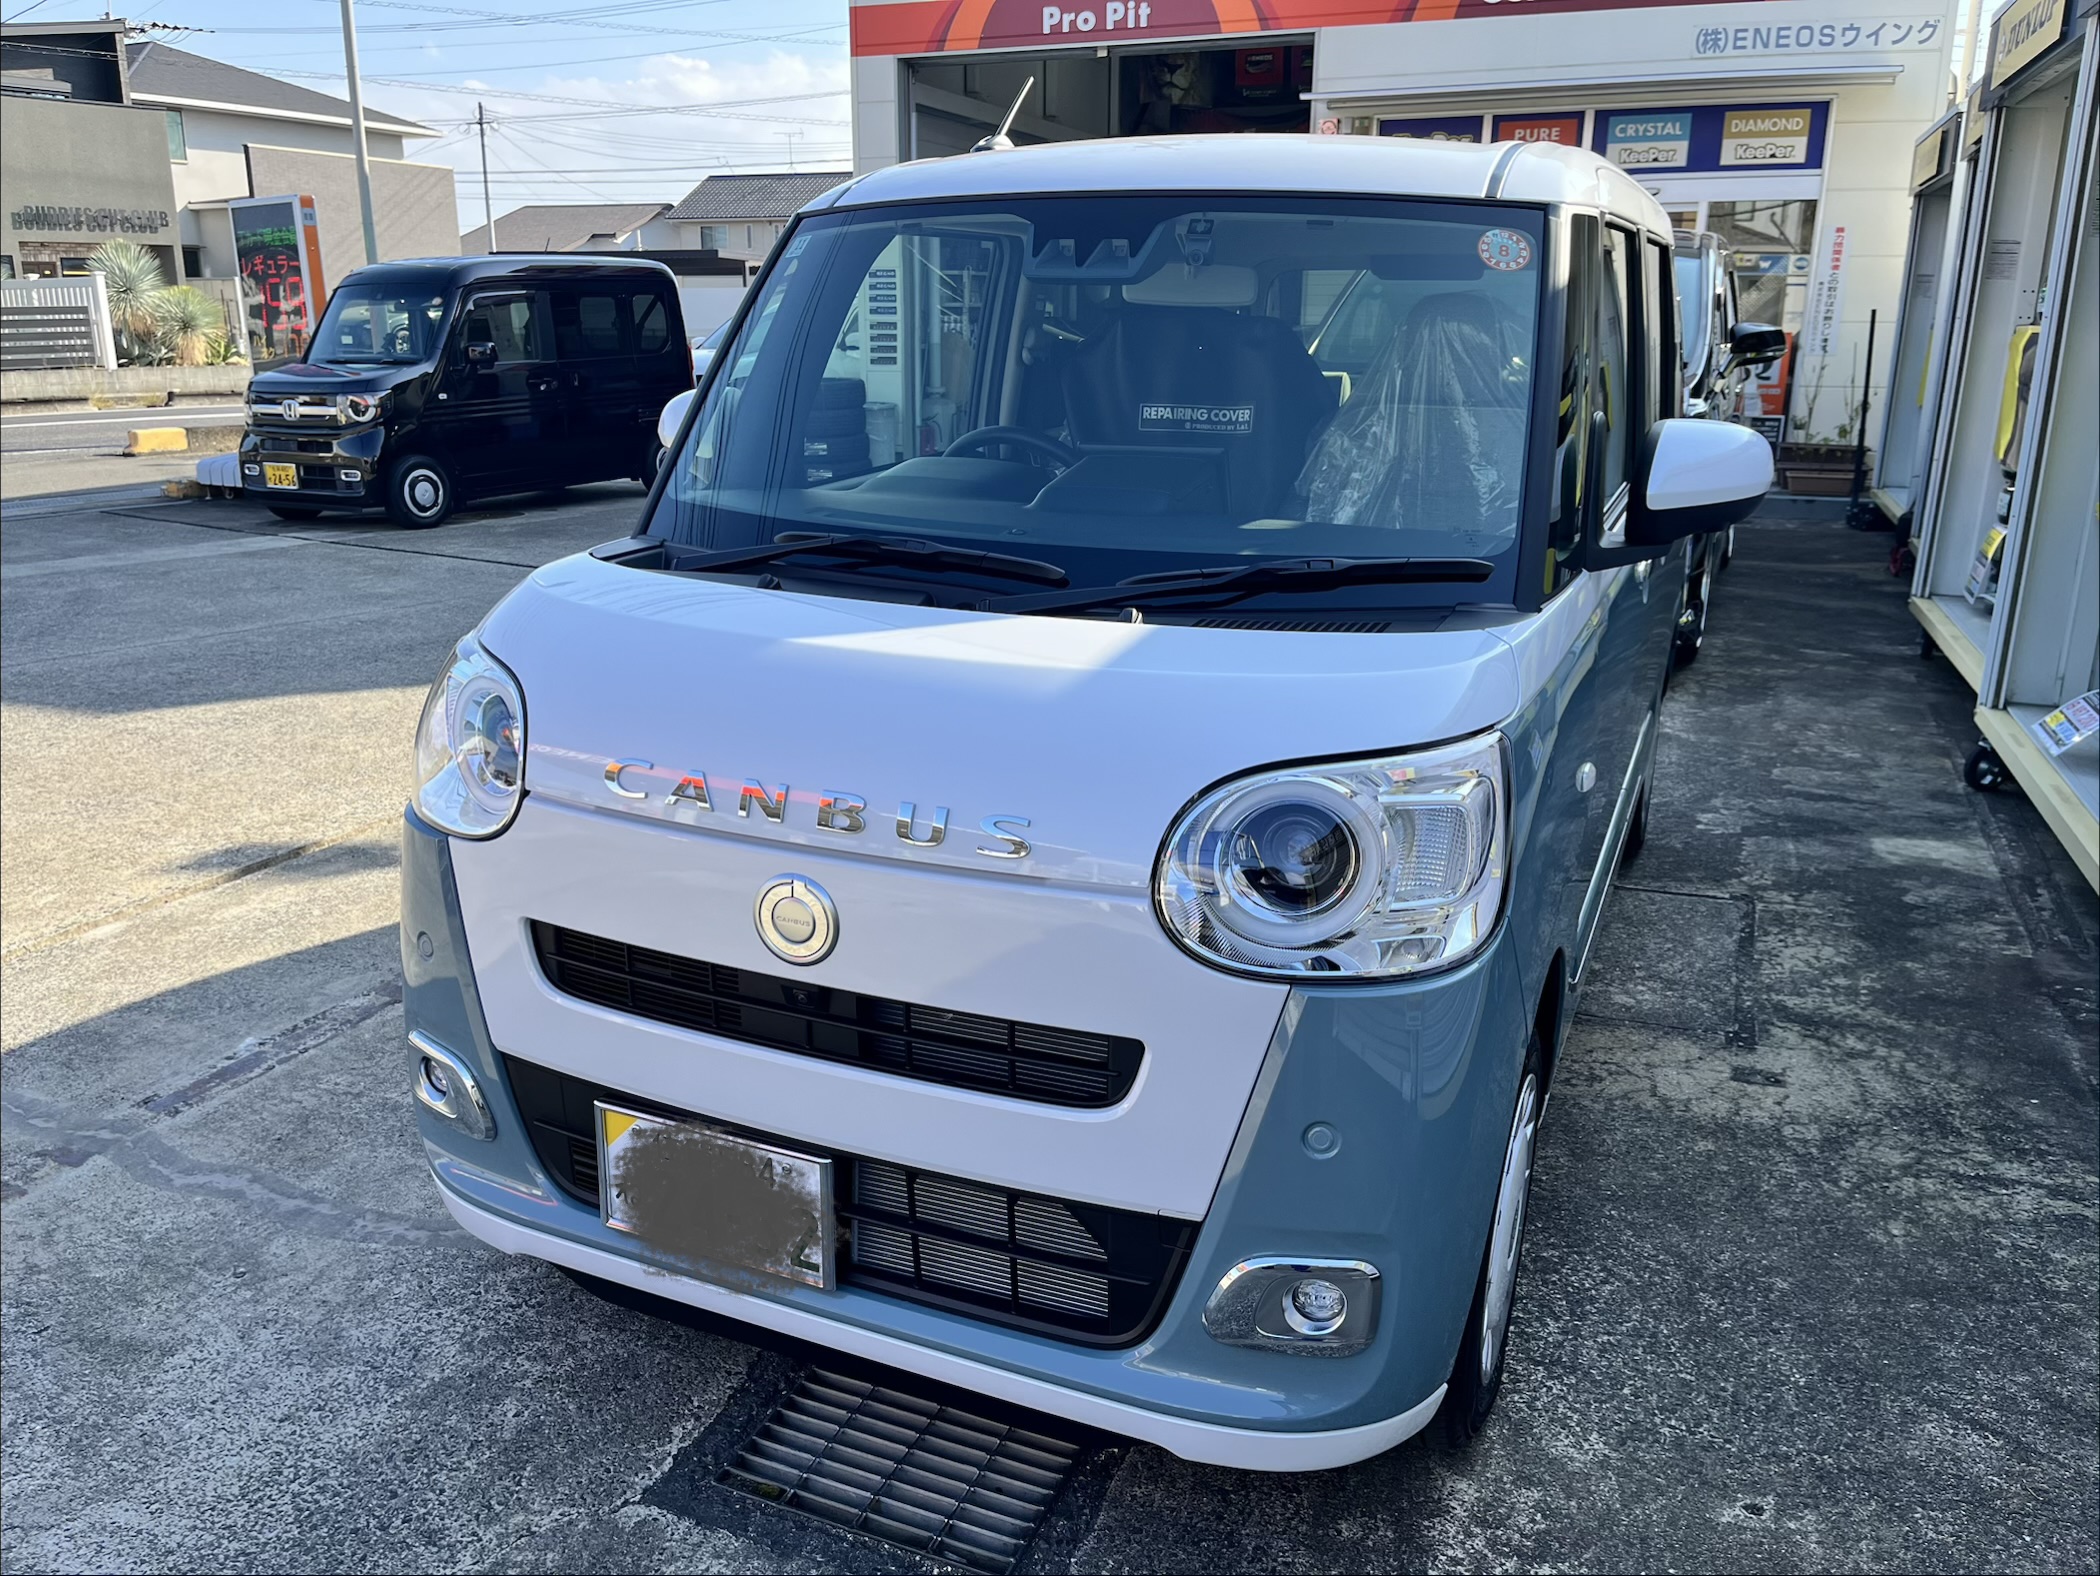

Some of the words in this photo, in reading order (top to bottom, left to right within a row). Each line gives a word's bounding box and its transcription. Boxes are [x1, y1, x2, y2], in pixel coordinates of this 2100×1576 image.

[1042, 6, 1097, 34] Pro
[1106, 0, 1152, 30] Pit
[1695, 19, 1941, 55] (株)ENEOSウイング
[1615, 121, 1683, 137] CRYSTAL
[1730, 117, 1804, 133] DIAMOND
[1513, 127, 1561, 142] PURE
[1618, 146, 1677, 164] KeePer
[1734, 142, 1795, 160] KeePer
[20, 205, 93, 229] BUDDIES
[1498, 244, 1510, 258] 8
[241, 254, 300, 276] レギュラー
[1142, 406, 1209, 420] REPAIRING
[1210, 409, 1251, 422] COVER
[603, 757, 1032, 860] CANBUS
[776, 915, 811, 928] CANBUS
